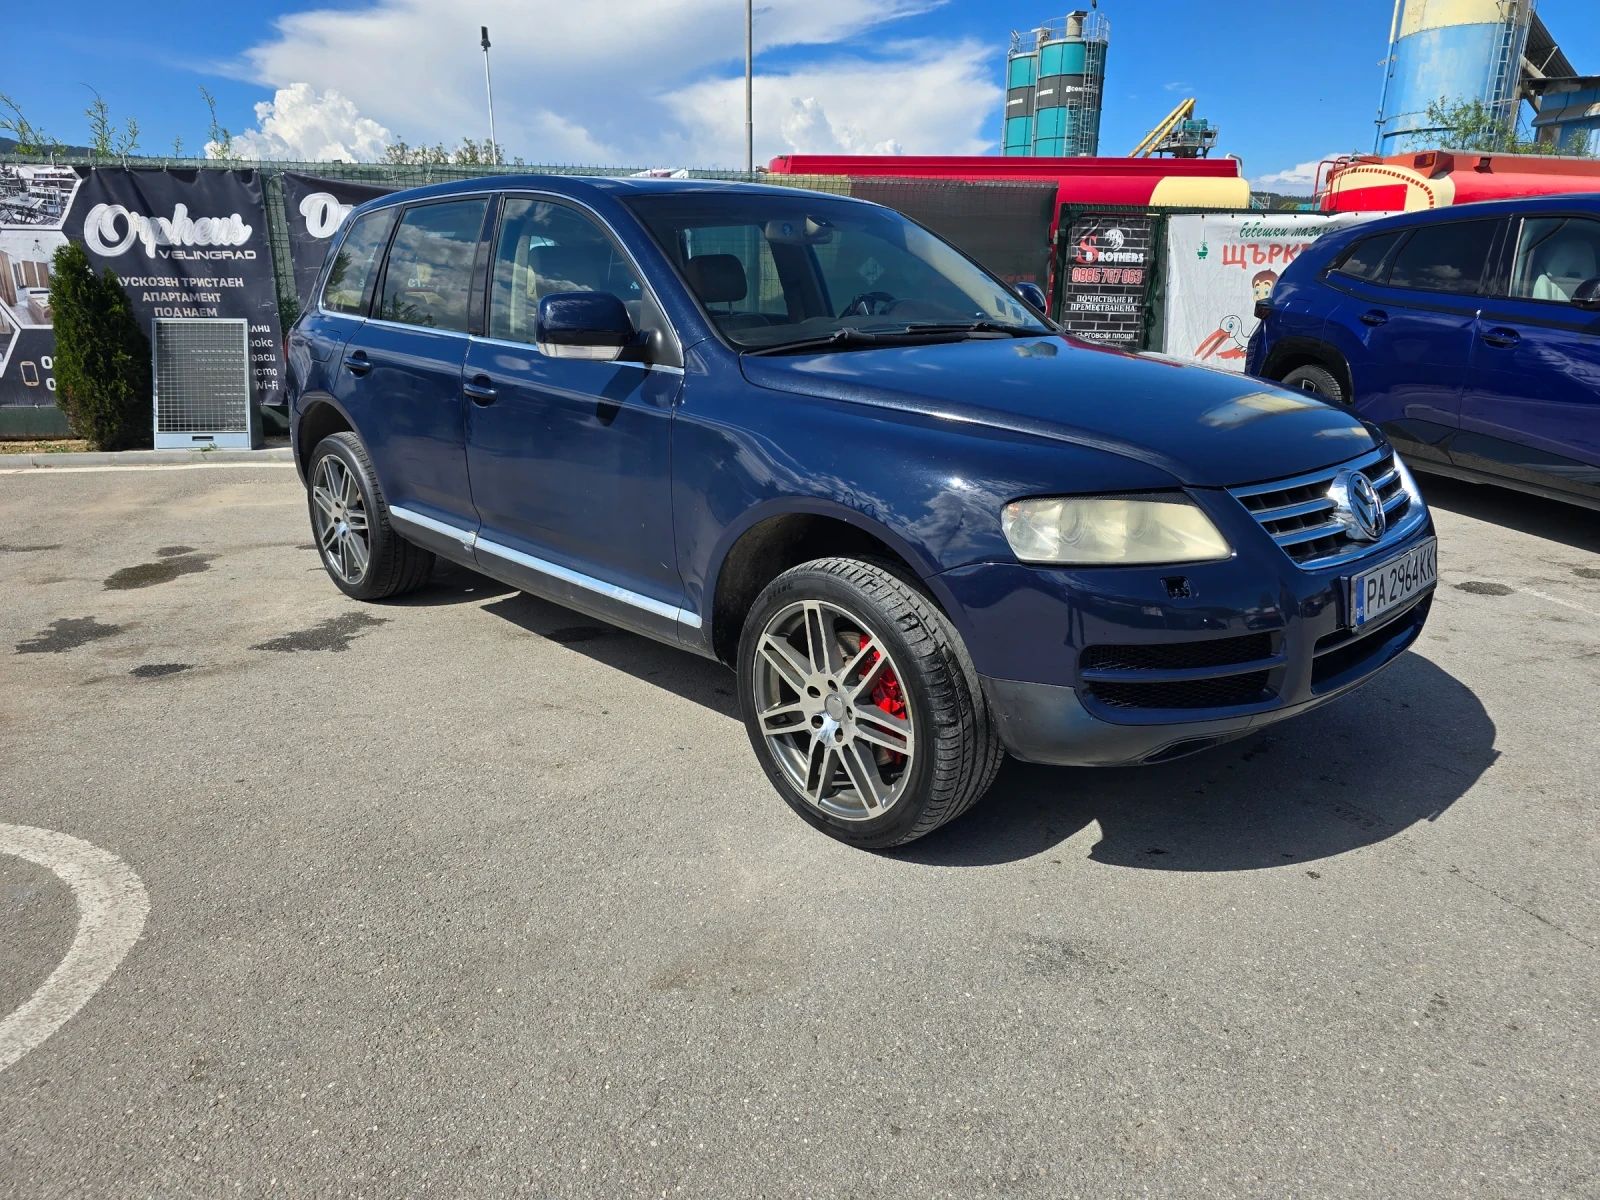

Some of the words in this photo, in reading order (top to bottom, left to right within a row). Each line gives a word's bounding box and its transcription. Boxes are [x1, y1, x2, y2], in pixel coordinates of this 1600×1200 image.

[84, 203, 253, 259] Orpheus
[1240, 221, 1288, 238] бебешки
[158, 250, 257, 260] VELINGRAD
[181, 277, 244, 288] ТРИСТАЕН
[142, 292, 221, 303] АПАРТАМЕНТ
[154, 307, 183, 318] ПОД
[183, 307, 218, 318] НАЕМ
[249, 325, 271, 333] лни
